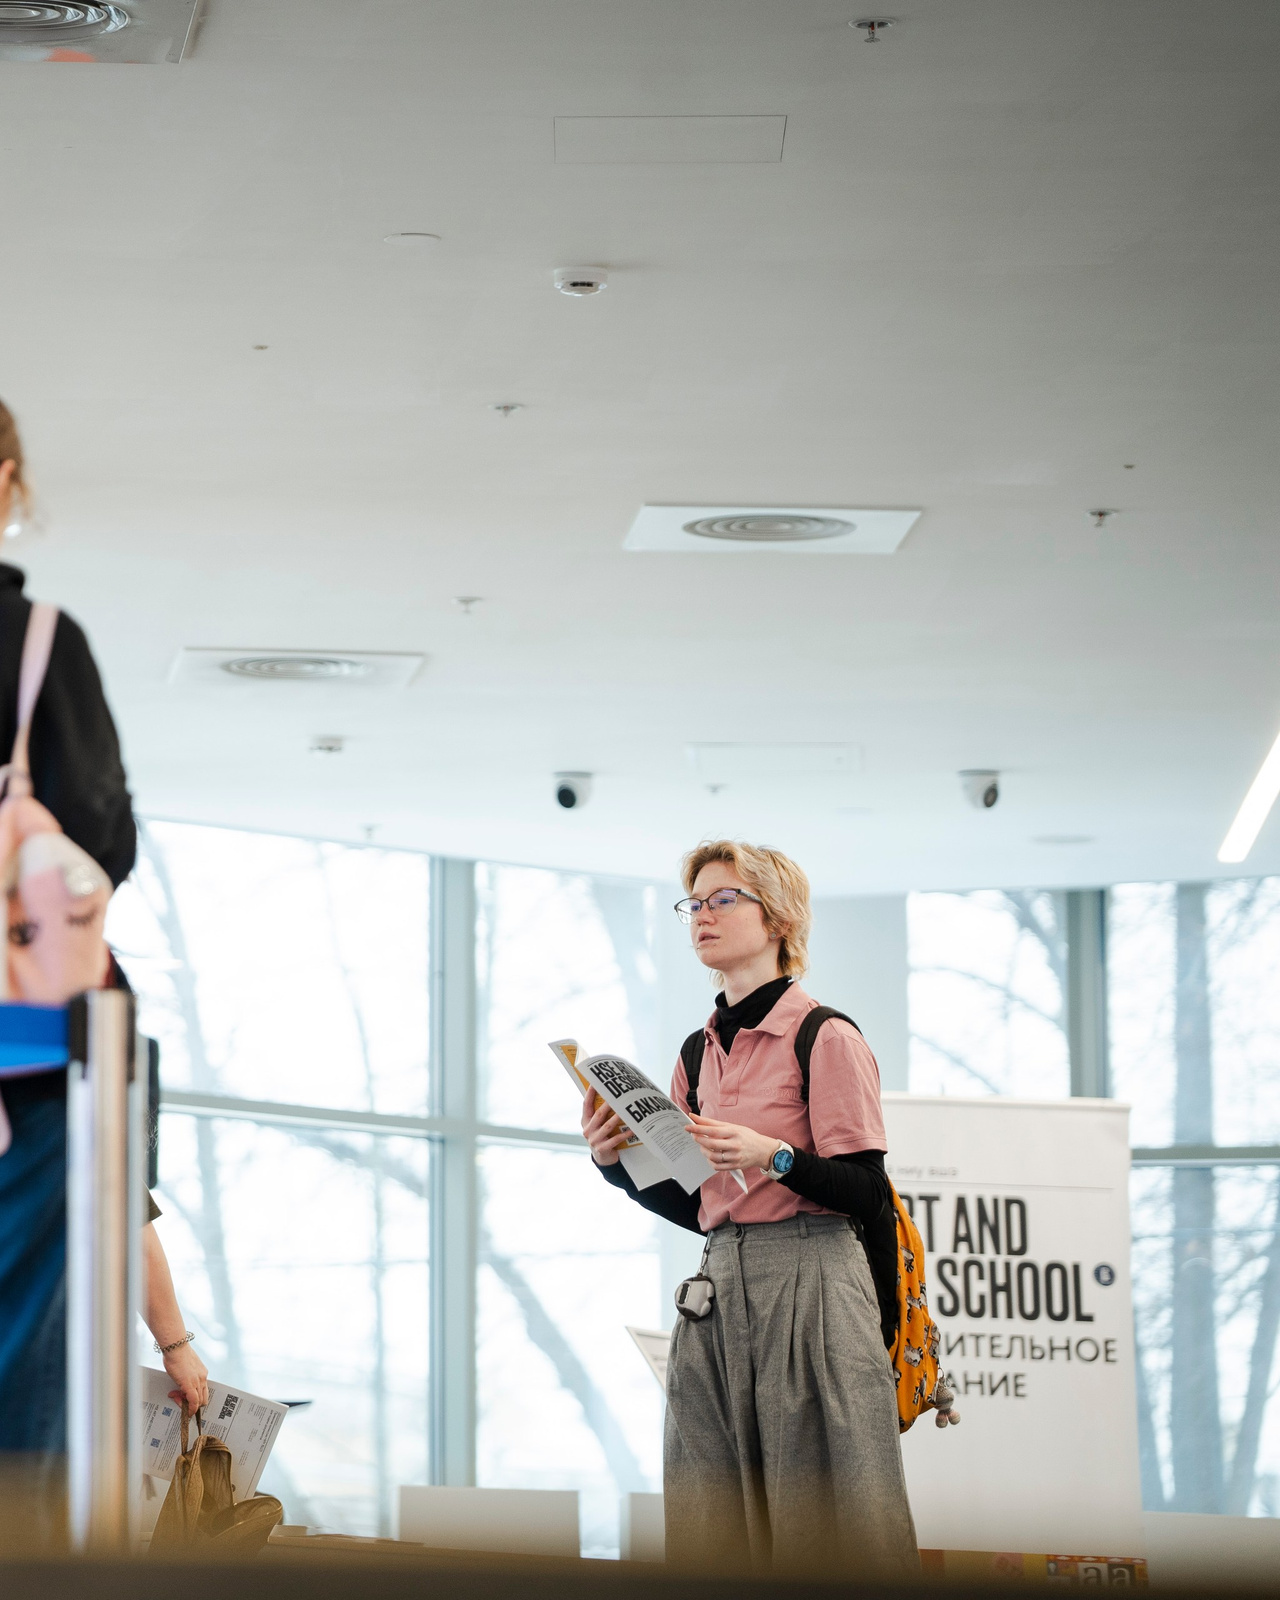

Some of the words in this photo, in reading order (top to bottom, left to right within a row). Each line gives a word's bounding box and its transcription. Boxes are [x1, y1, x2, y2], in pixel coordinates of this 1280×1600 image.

[590, 1060, 619, 1083] HSE
[953, 1195, 1028, 1256] AND
[937, 1258, 1094, 1322] SCHOOL
[940, 1331, 1118, 1363] ИТЕЛЬНОЕ
[948, 1370, 1028, 1398] АНИЕ
